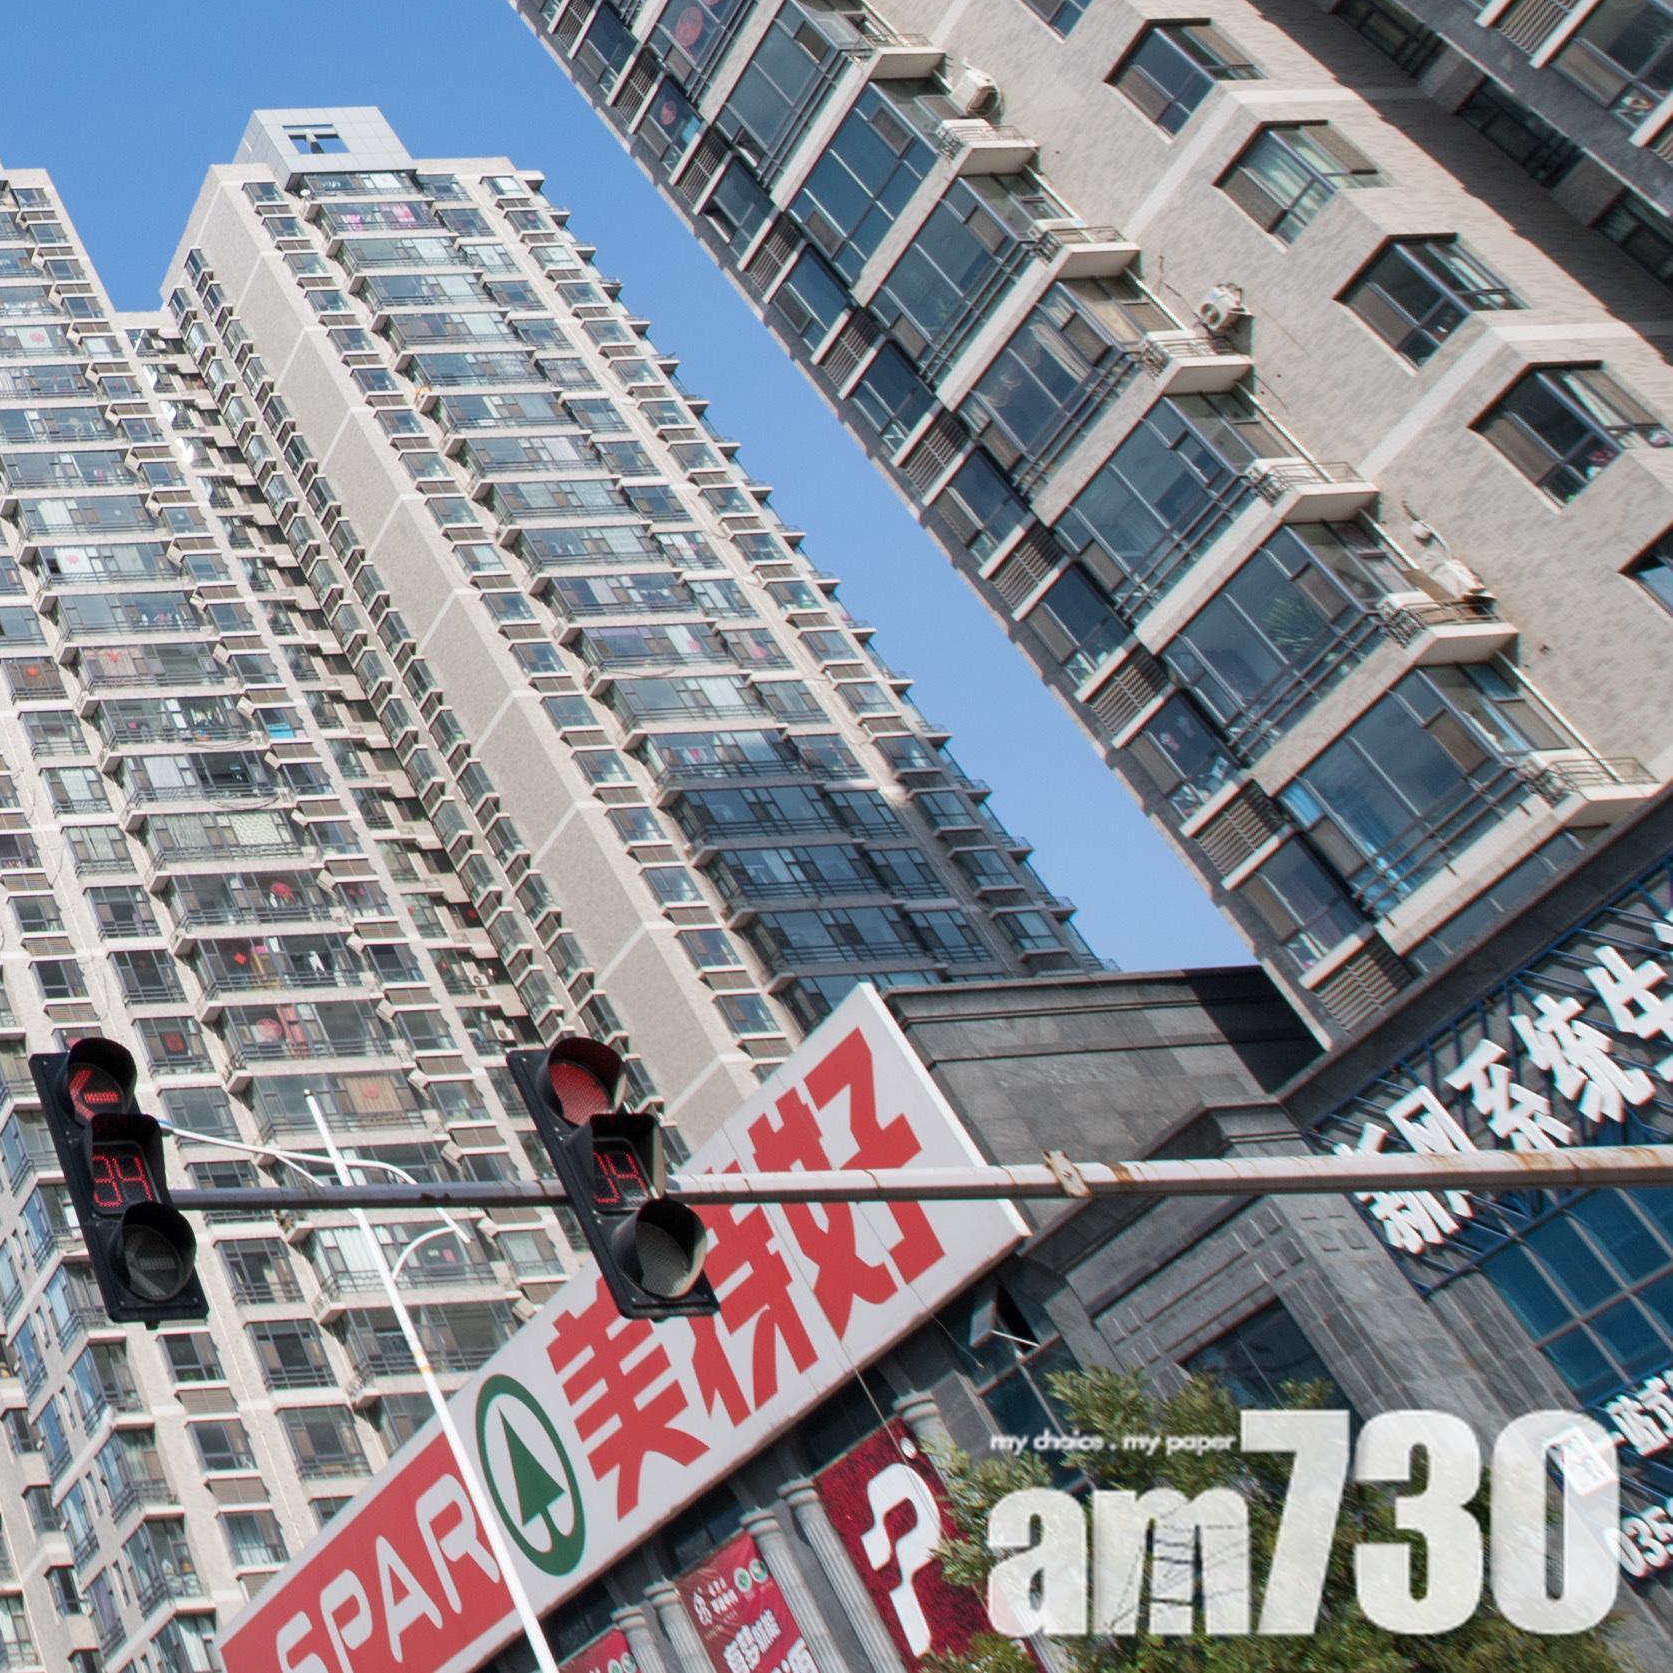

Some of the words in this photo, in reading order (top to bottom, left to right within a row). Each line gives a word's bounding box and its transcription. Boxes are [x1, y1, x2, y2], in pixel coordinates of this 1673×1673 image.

[546, 1027, 945, 1522] 美特好
[276, 1473, 500, 1673] SPAR
